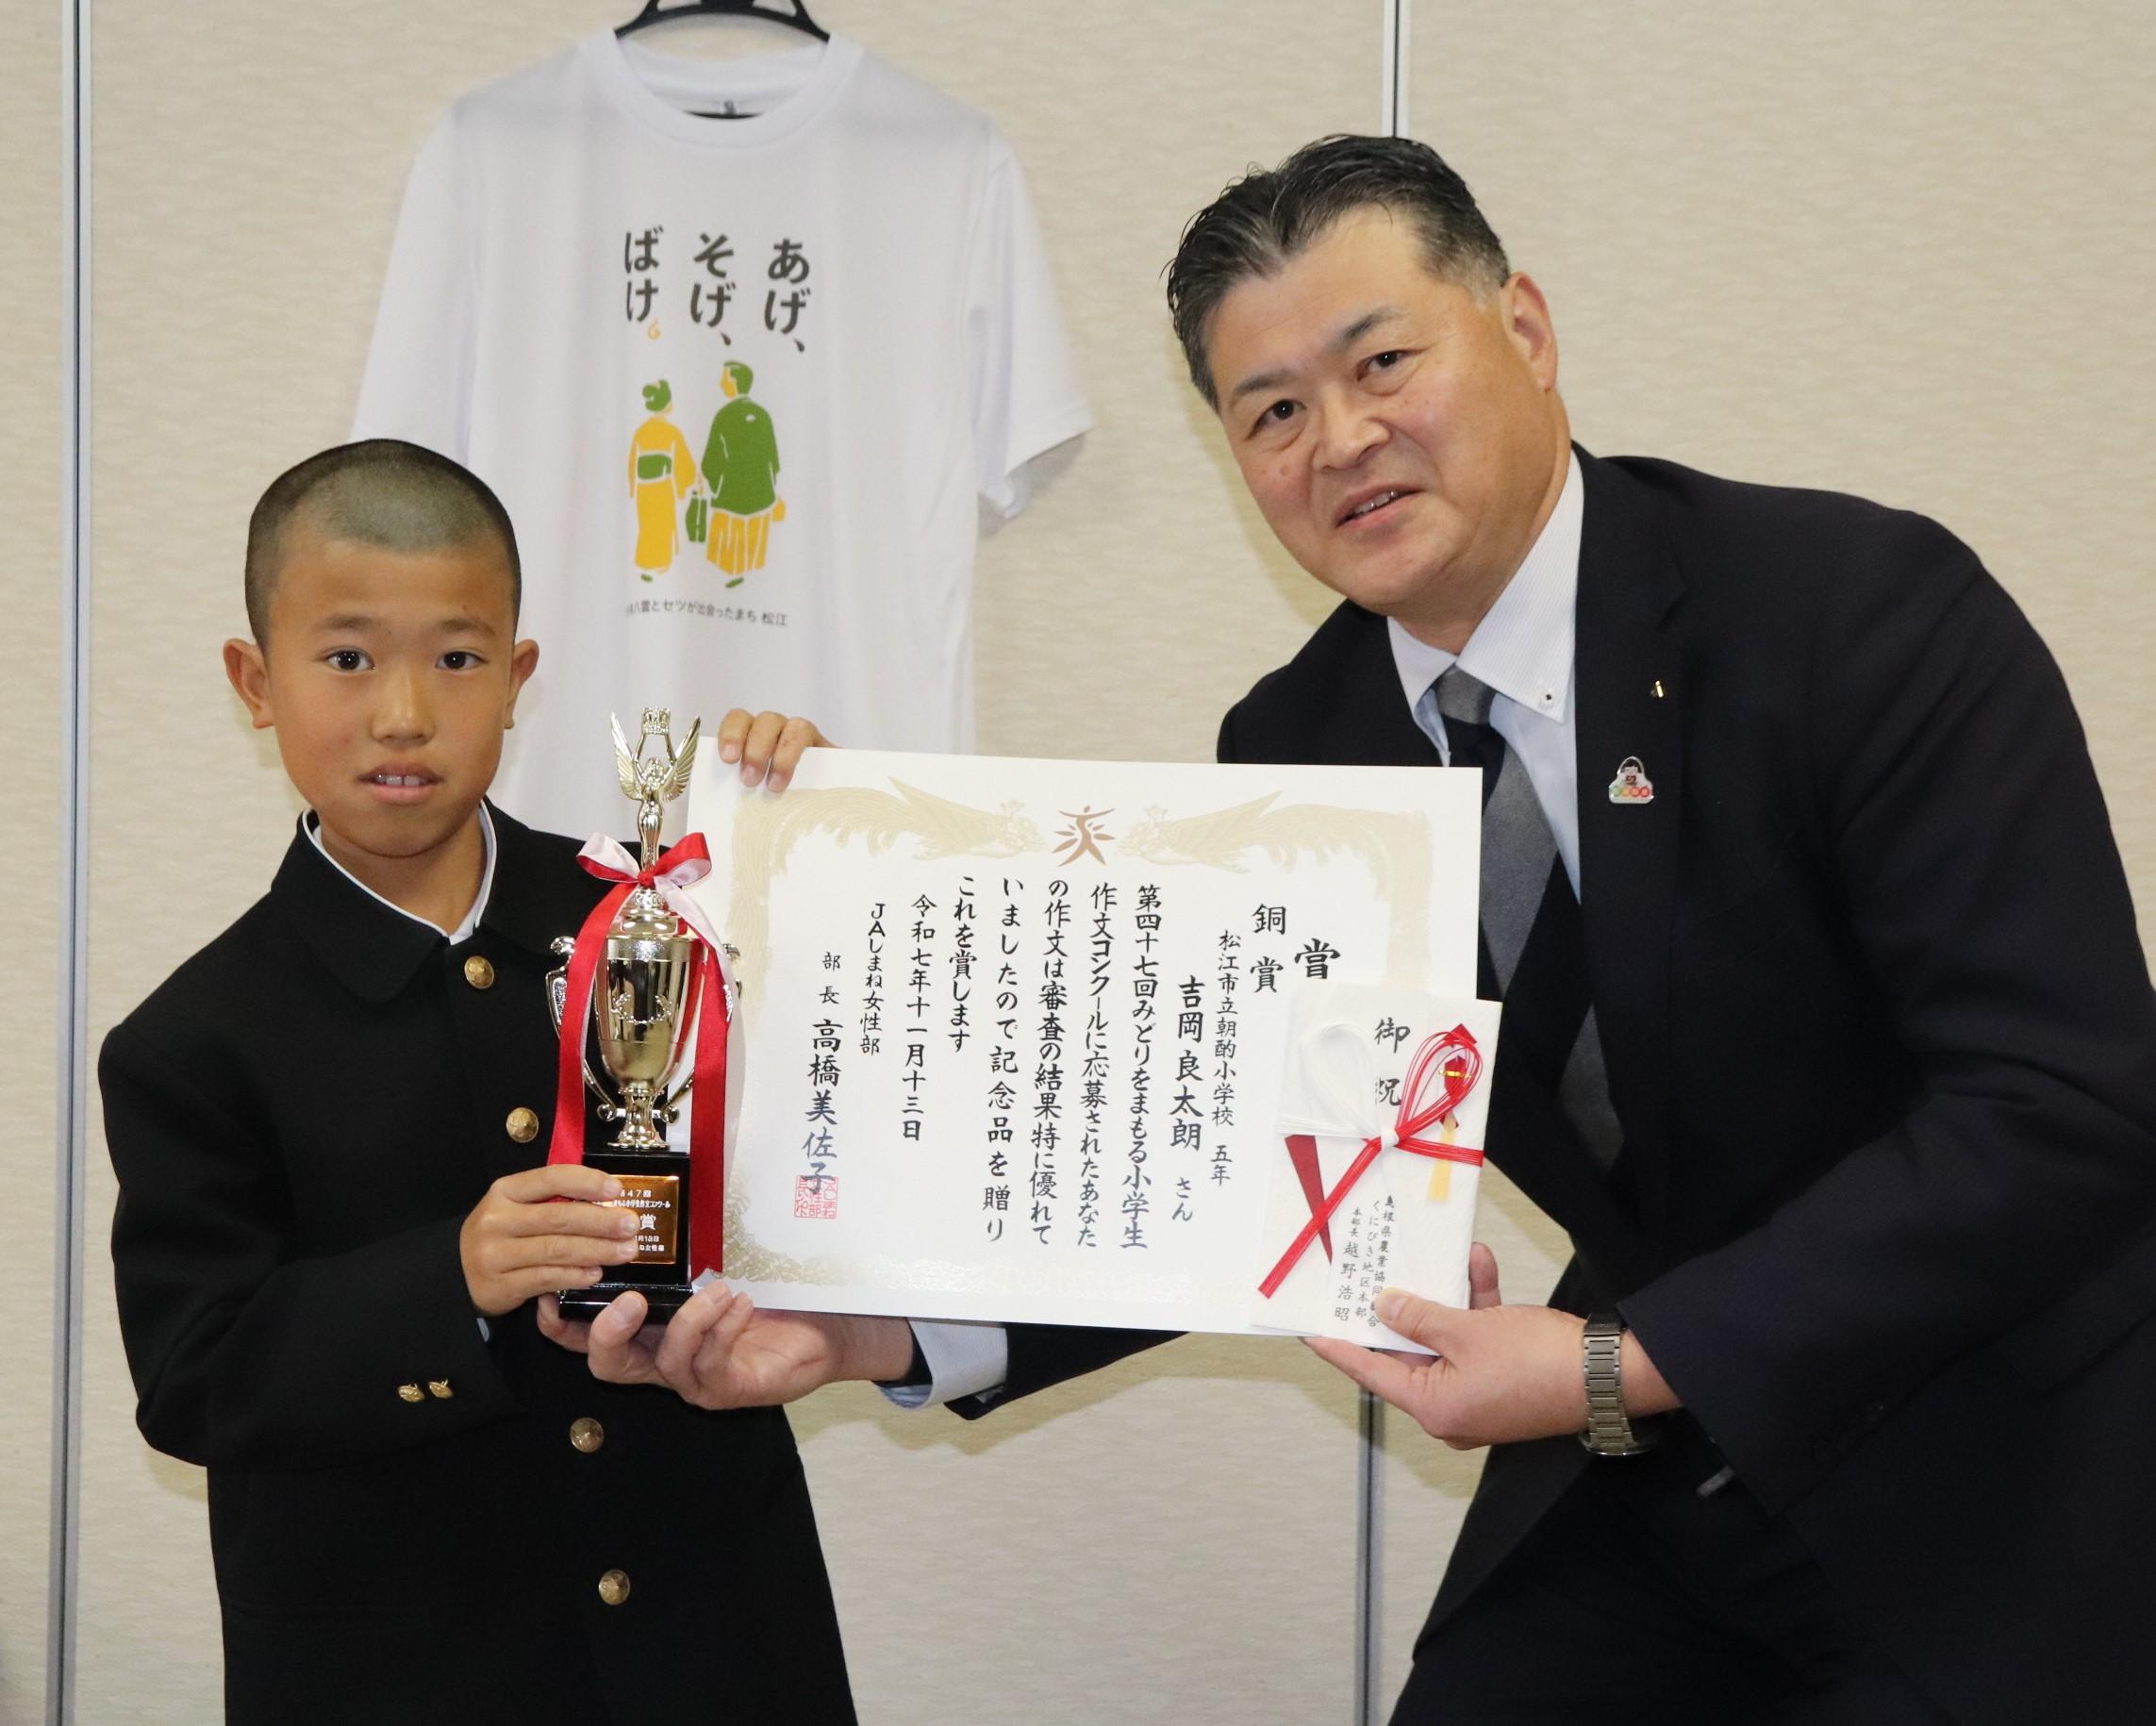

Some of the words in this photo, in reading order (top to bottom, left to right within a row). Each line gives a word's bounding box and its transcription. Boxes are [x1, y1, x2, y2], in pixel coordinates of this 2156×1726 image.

[690, 232, 737, 346] そげ、
[764, 239, 810, 353] あげ、
[819, 951, 841, 1004] 部長
[860, 903, 887, 1055] JAしまね女性部
[902, 893, 937, 1142] 令和七年十一月十三日
[948, 875, 978, 1053] これを賞します
[1212, 929, 1242, 1127] 松江市立朝酌小学校
[1250, 903, 1286, 993] 銅賞
[801, 1019, 844, 1195] 高橋美佐子
[982, 876, 1024, 1242] いましたので記念品を贈り
[1029, 879, 1071, 1245] の作文は審査の結果特に優れて
[1077, 882, 1118, 1248] 作文コンクールに応募されたあなた
[1119, 885, 1163, 1249] 第四十七回みどりをまもる小学生
[1169, 974, 1206, 1152] 吉岡良太朗
[640, 1213, 656, 1230] 賞
[1171, 1176, 1194, 1221] さん
[1210, 1144, 1233, 1187] 五年
